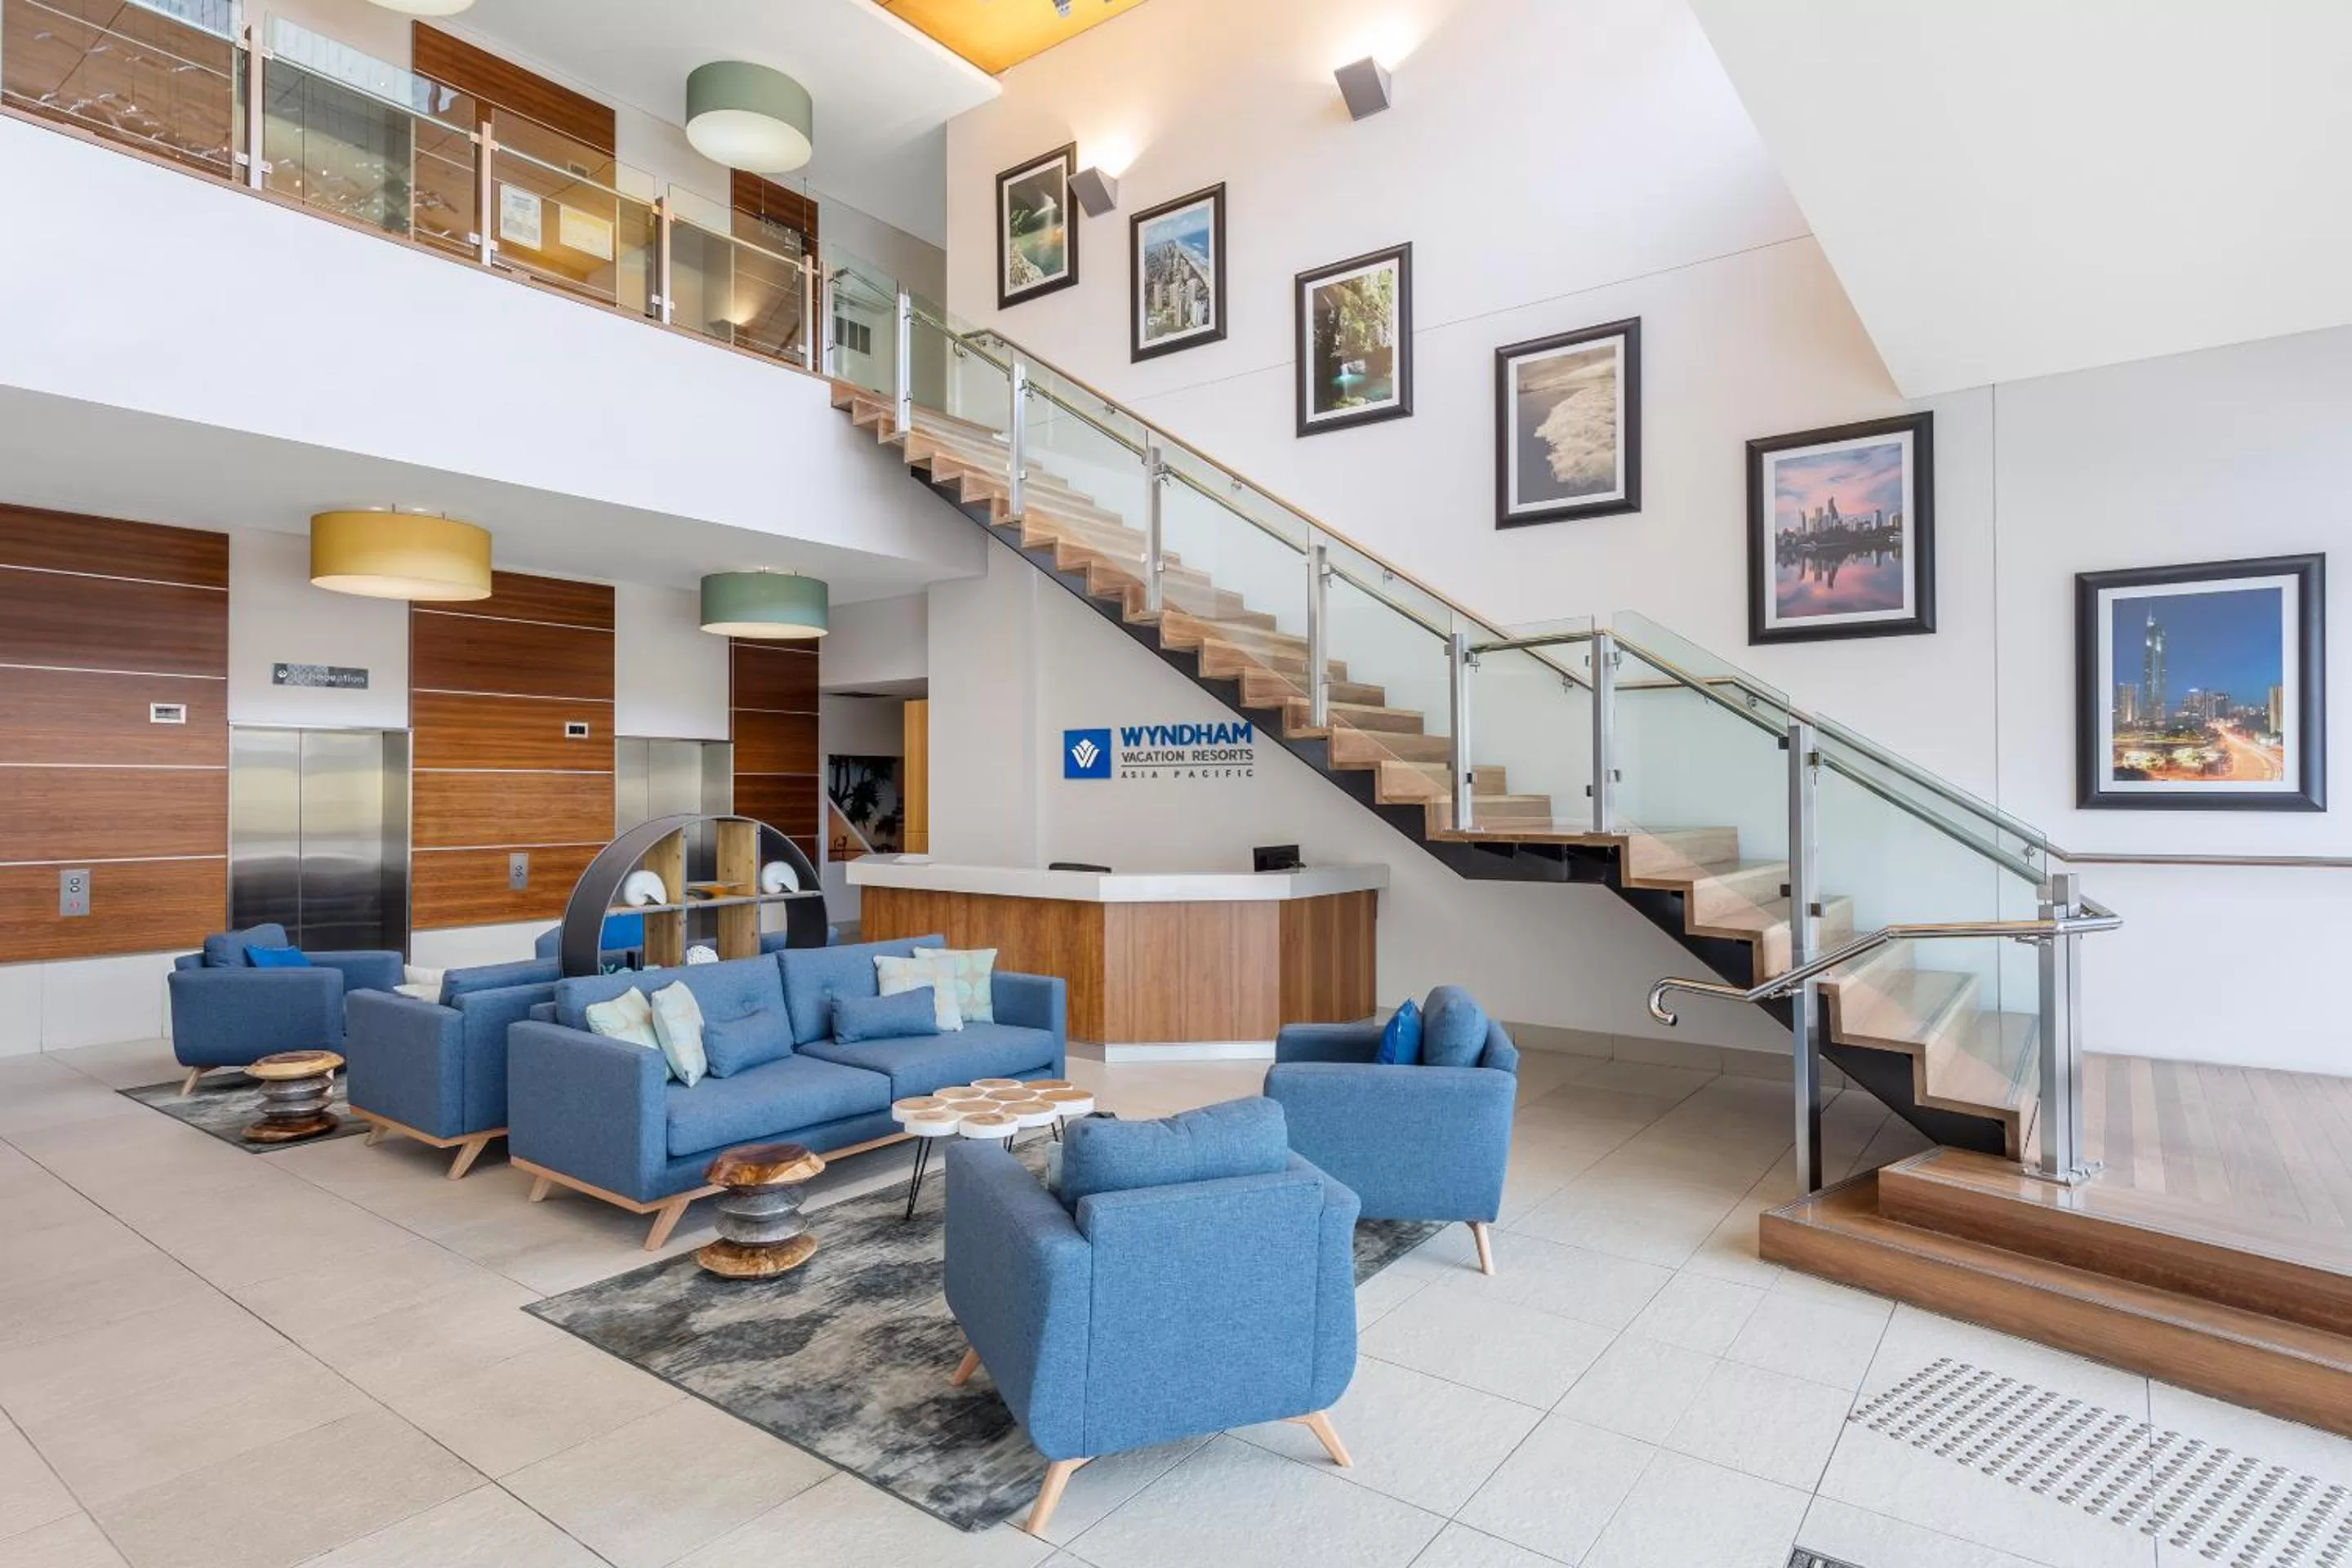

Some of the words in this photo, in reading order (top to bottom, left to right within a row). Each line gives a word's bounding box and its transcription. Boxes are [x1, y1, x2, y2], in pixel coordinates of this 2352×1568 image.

[1120, 721, 1253, 747] WYNDHAM
[1121, 751, 1185, 763] VACATION
[1192, 748, 1254, 762] RESORTS
[1120, 770, 1158, 778] ASIA
[1174, 768, 1254, 778] PACIFIC
